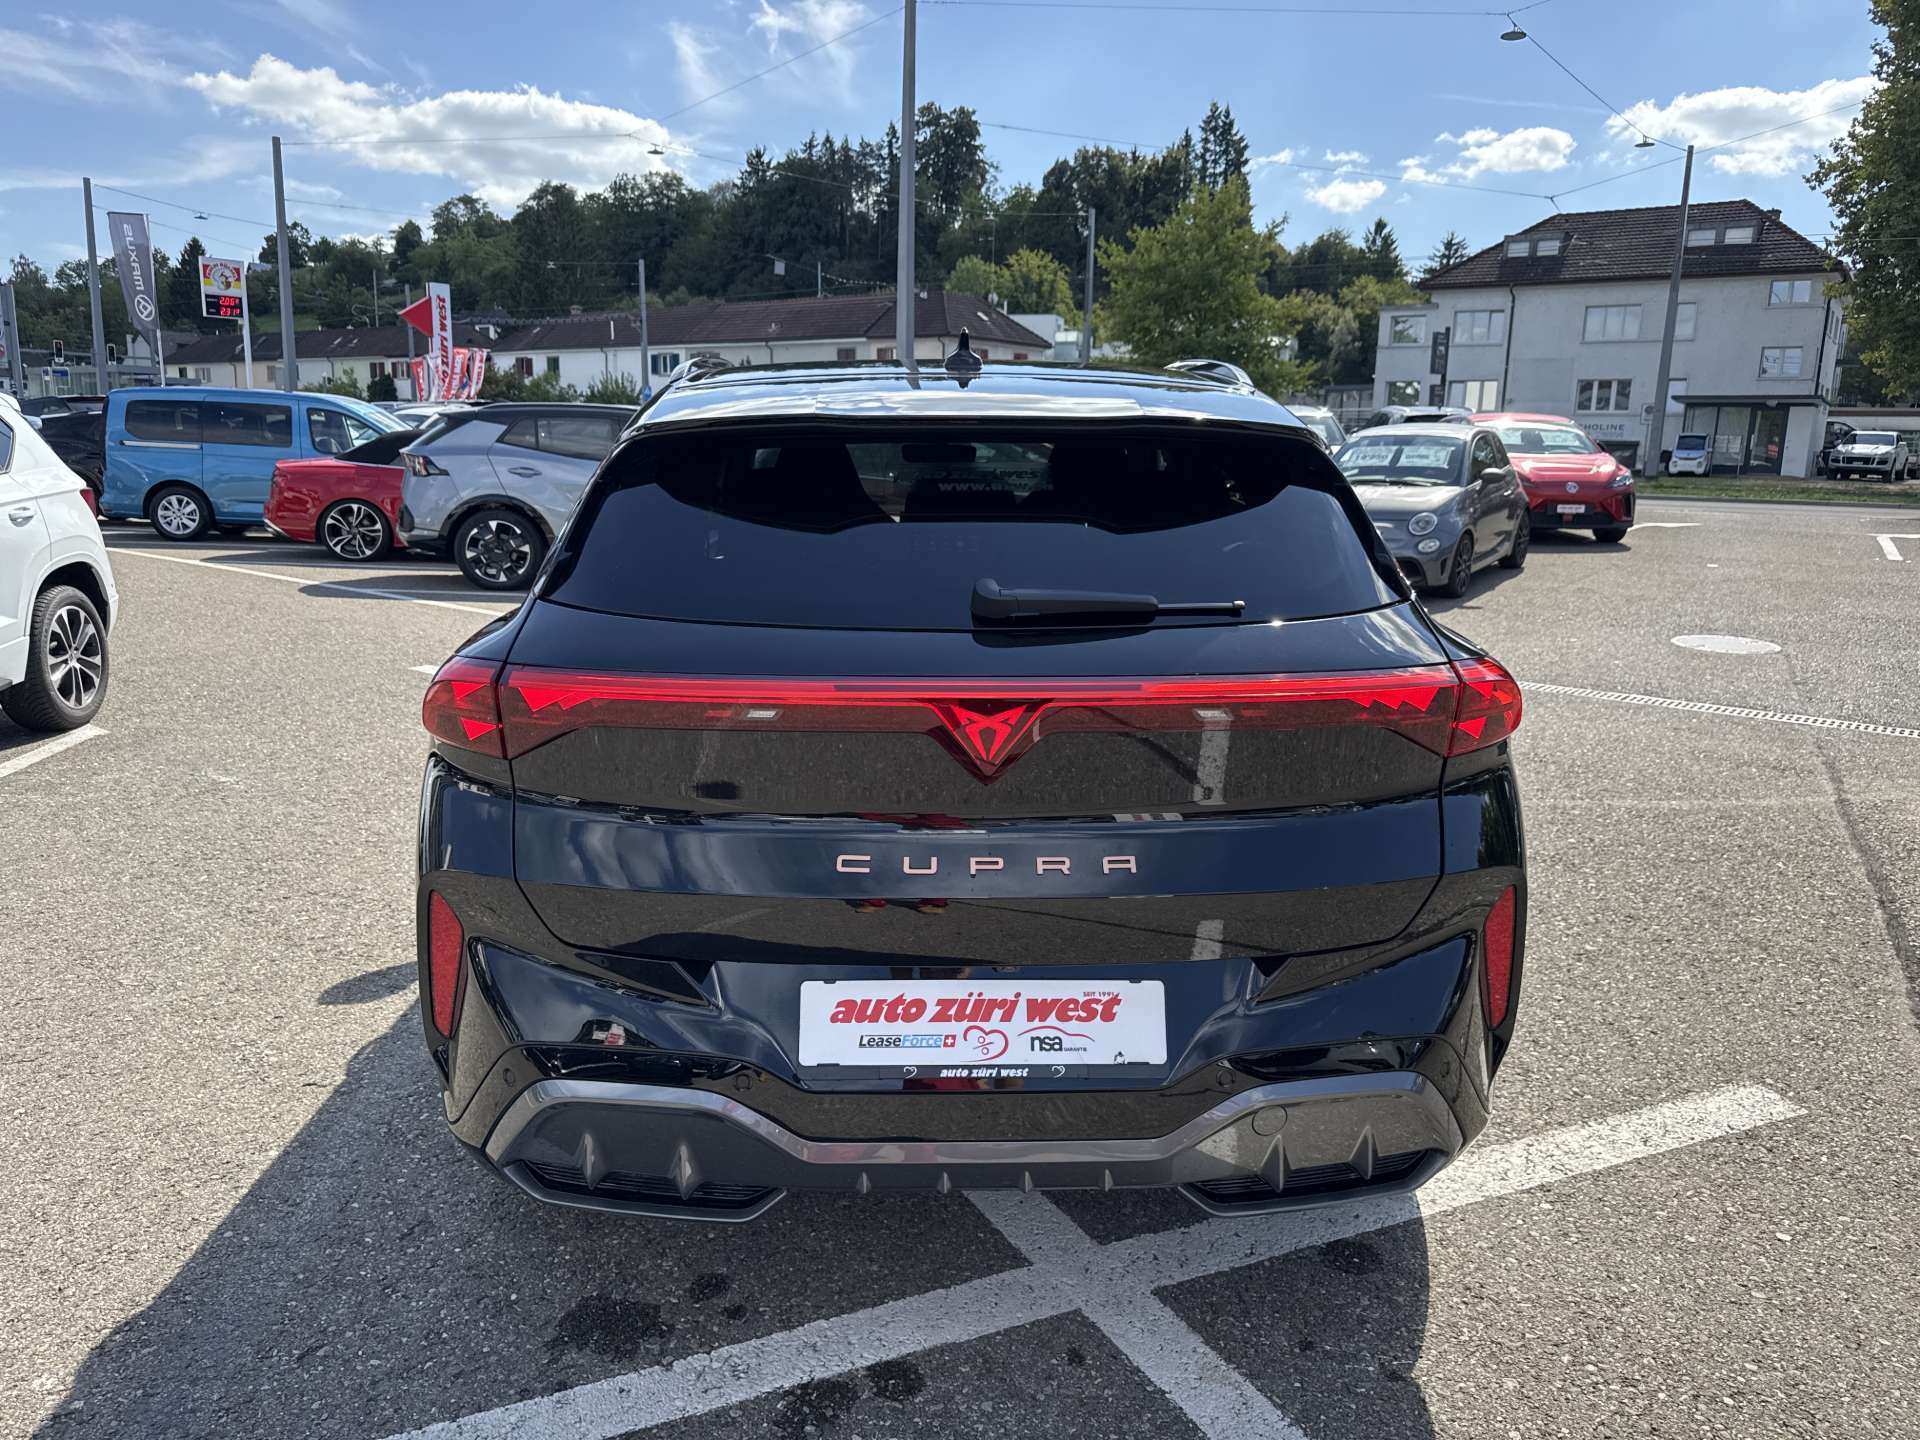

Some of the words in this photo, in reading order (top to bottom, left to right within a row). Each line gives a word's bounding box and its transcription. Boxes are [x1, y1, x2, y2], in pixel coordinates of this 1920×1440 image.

[836, 855, 1137, 875] CUPRA
[830, 993, 927, 1024] auto
[928, 991, 1022, 1023] züri
[1026, 993, 1122, 1023] west
[858, 1034, 942, 1048] LeaseForce
[1030, 1033, 1063, 1052] nsa
[940, 1068, 968, 1077] auto
[970, 1067, 997, 1078] züri
[1000, 1068, 1029, 1077] west
